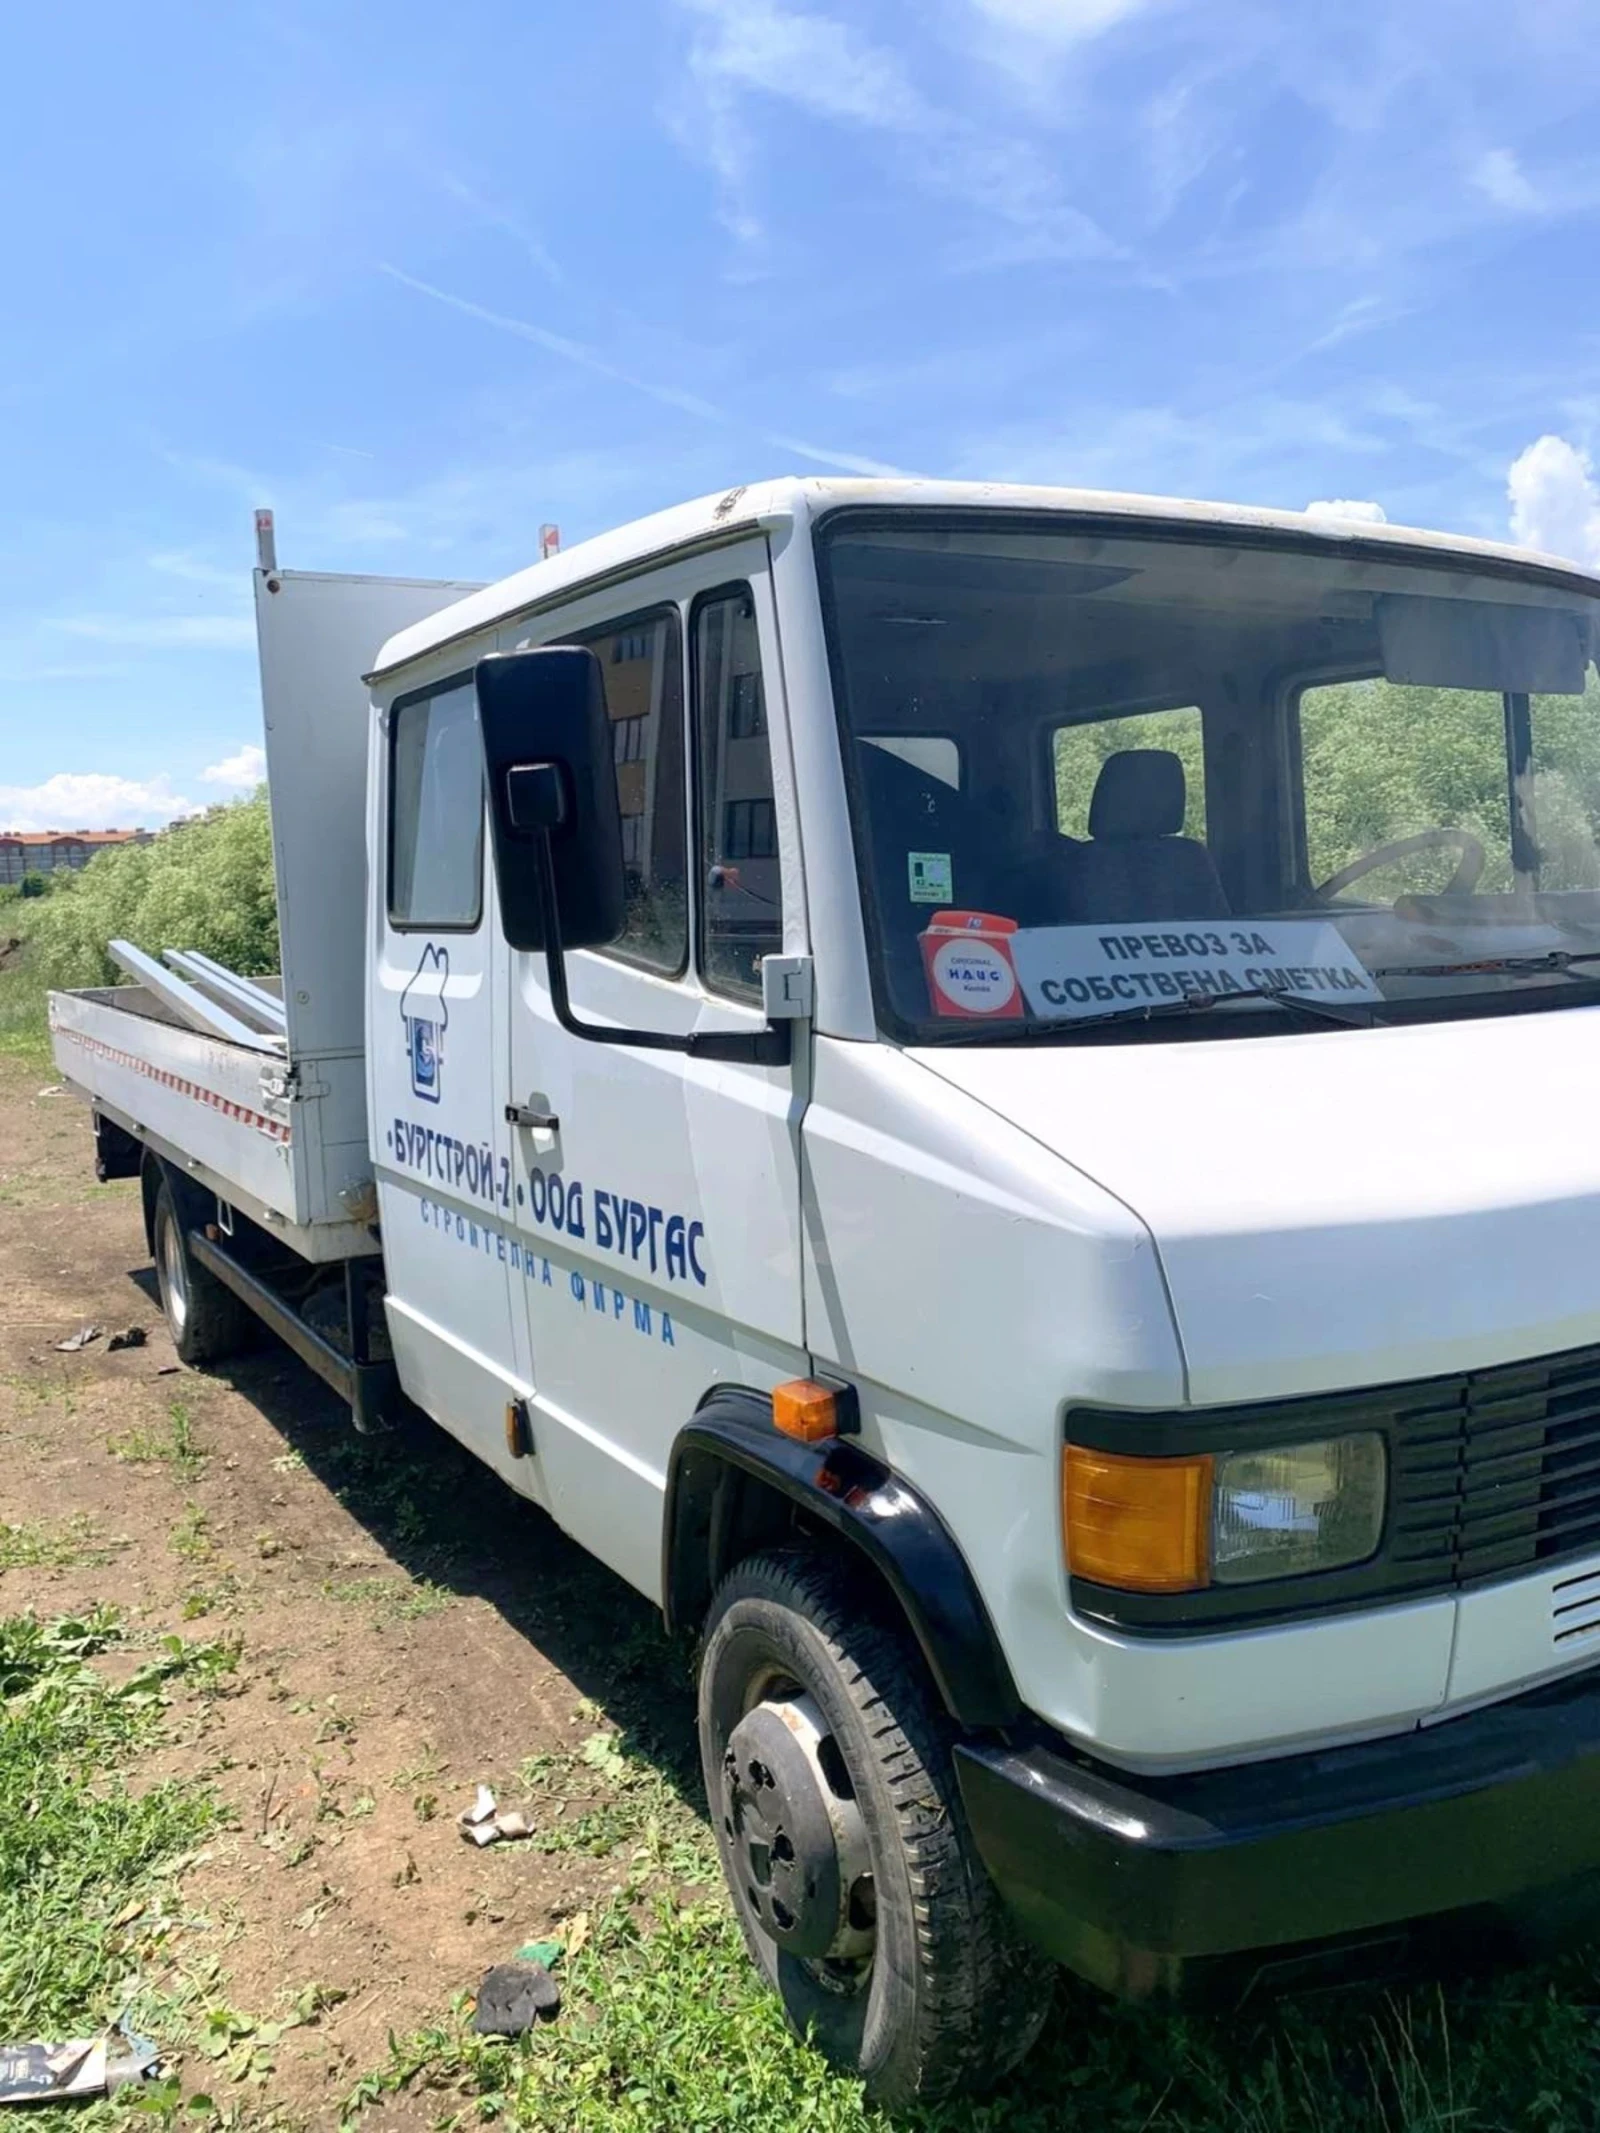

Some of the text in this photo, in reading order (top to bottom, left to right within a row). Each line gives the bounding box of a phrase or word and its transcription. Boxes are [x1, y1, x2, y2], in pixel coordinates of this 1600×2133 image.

[1040, 966, 1368, 1006] СОБСТВЕНА СМЕТКА
[1099, 932, 1276, 960] ПРЕВОЗ ЗА
[530, 1167, 585, 1239] ООД
[594, 1189, 707, 1287] БУРГАС
[421, 1197, 675, 1346] СТРОИТЕЛНА ФИРМА
